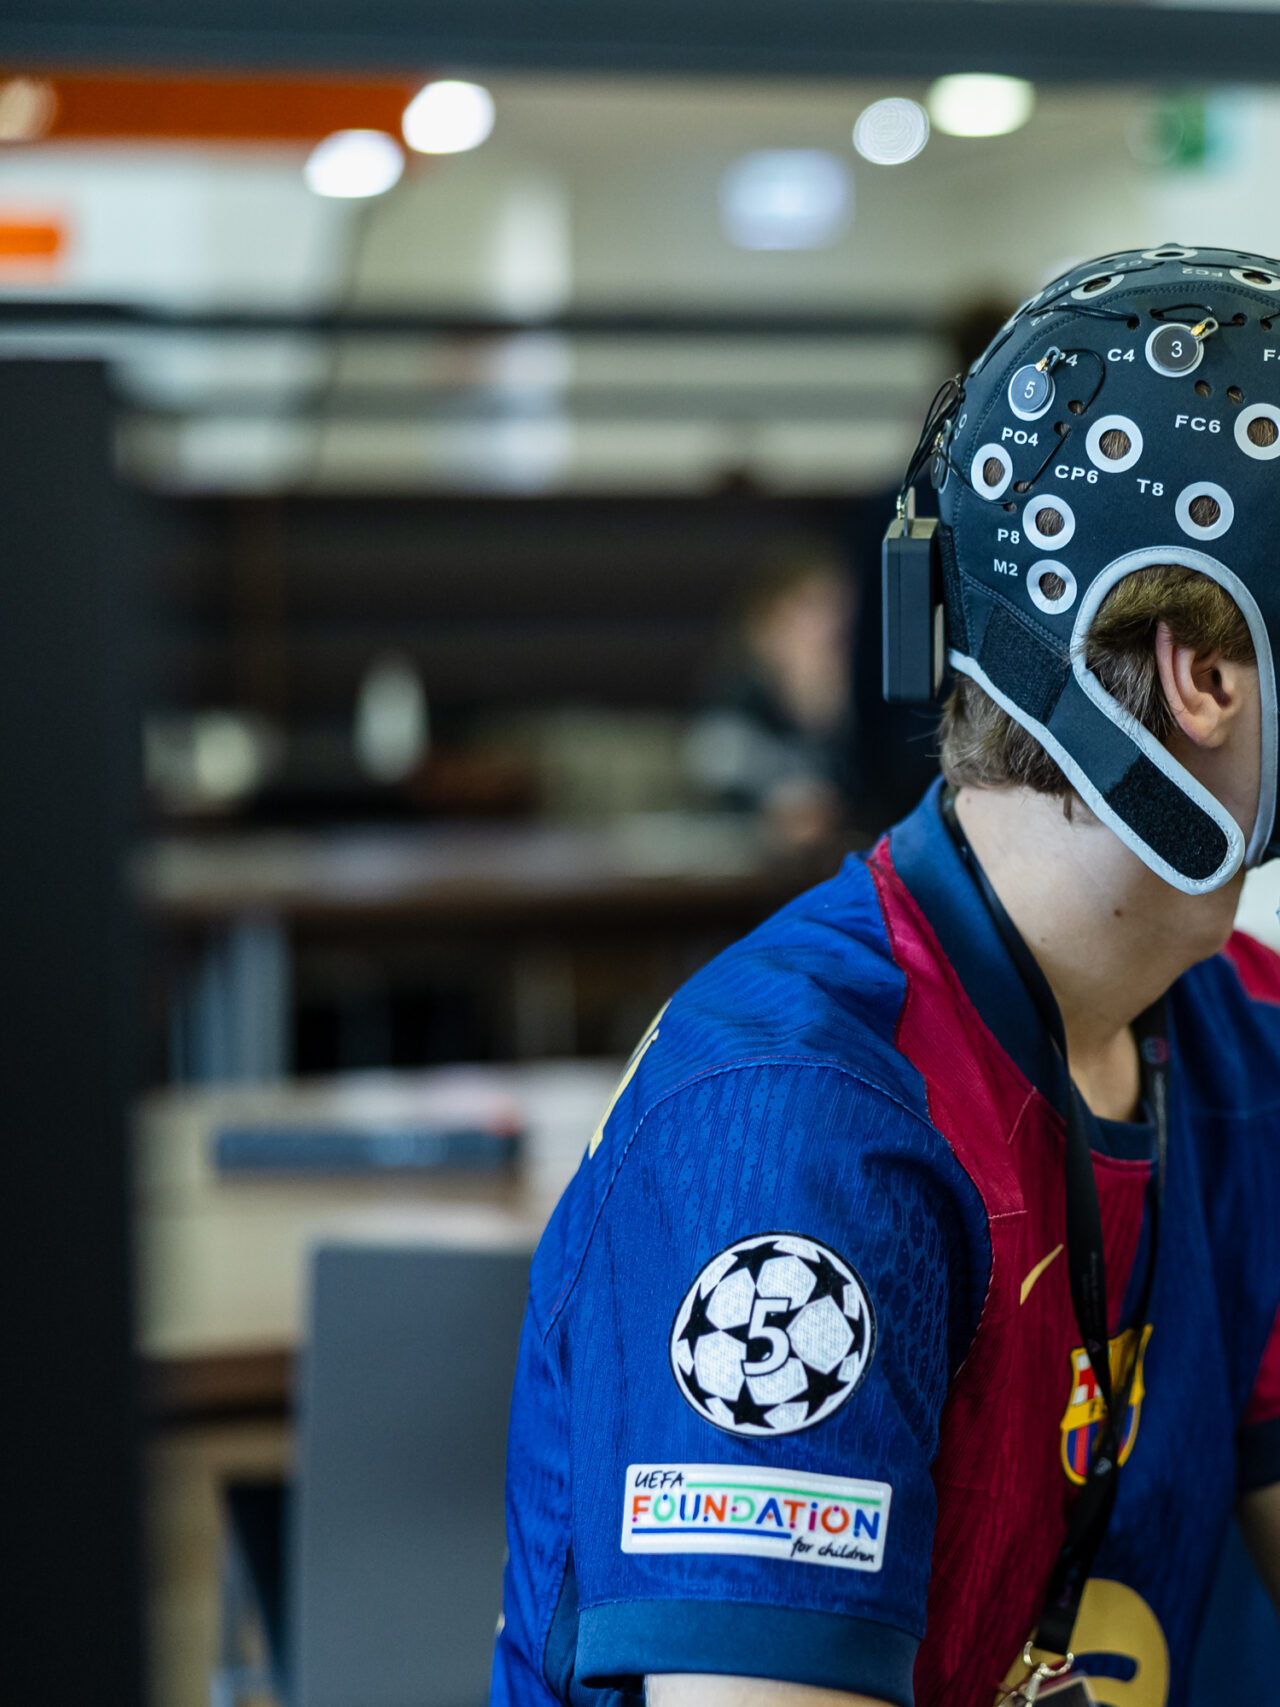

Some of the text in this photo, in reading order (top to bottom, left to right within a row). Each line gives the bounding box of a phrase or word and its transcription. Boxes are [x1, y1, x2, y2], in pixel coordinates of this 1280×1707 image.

[1107, 348, 1135, 362] C4
[1171, 340, 1183, 358] 3
[1023, 380, 1036, 399] 5
[1174, 414, 1221, 434] FC6
[1001, 427, 1039, 447] PO4
[1054, 464, 1099, 484] CP6
[1136, 478, 1164, 497] T8
[997, 528, 1020, 545] P8
[993, 559, 1019, 577] M2
[740, 1297, 793, 1378] 5
[634, 1470, 685, 1489] UEFA
[790, 1536, 875, 1564] for children
